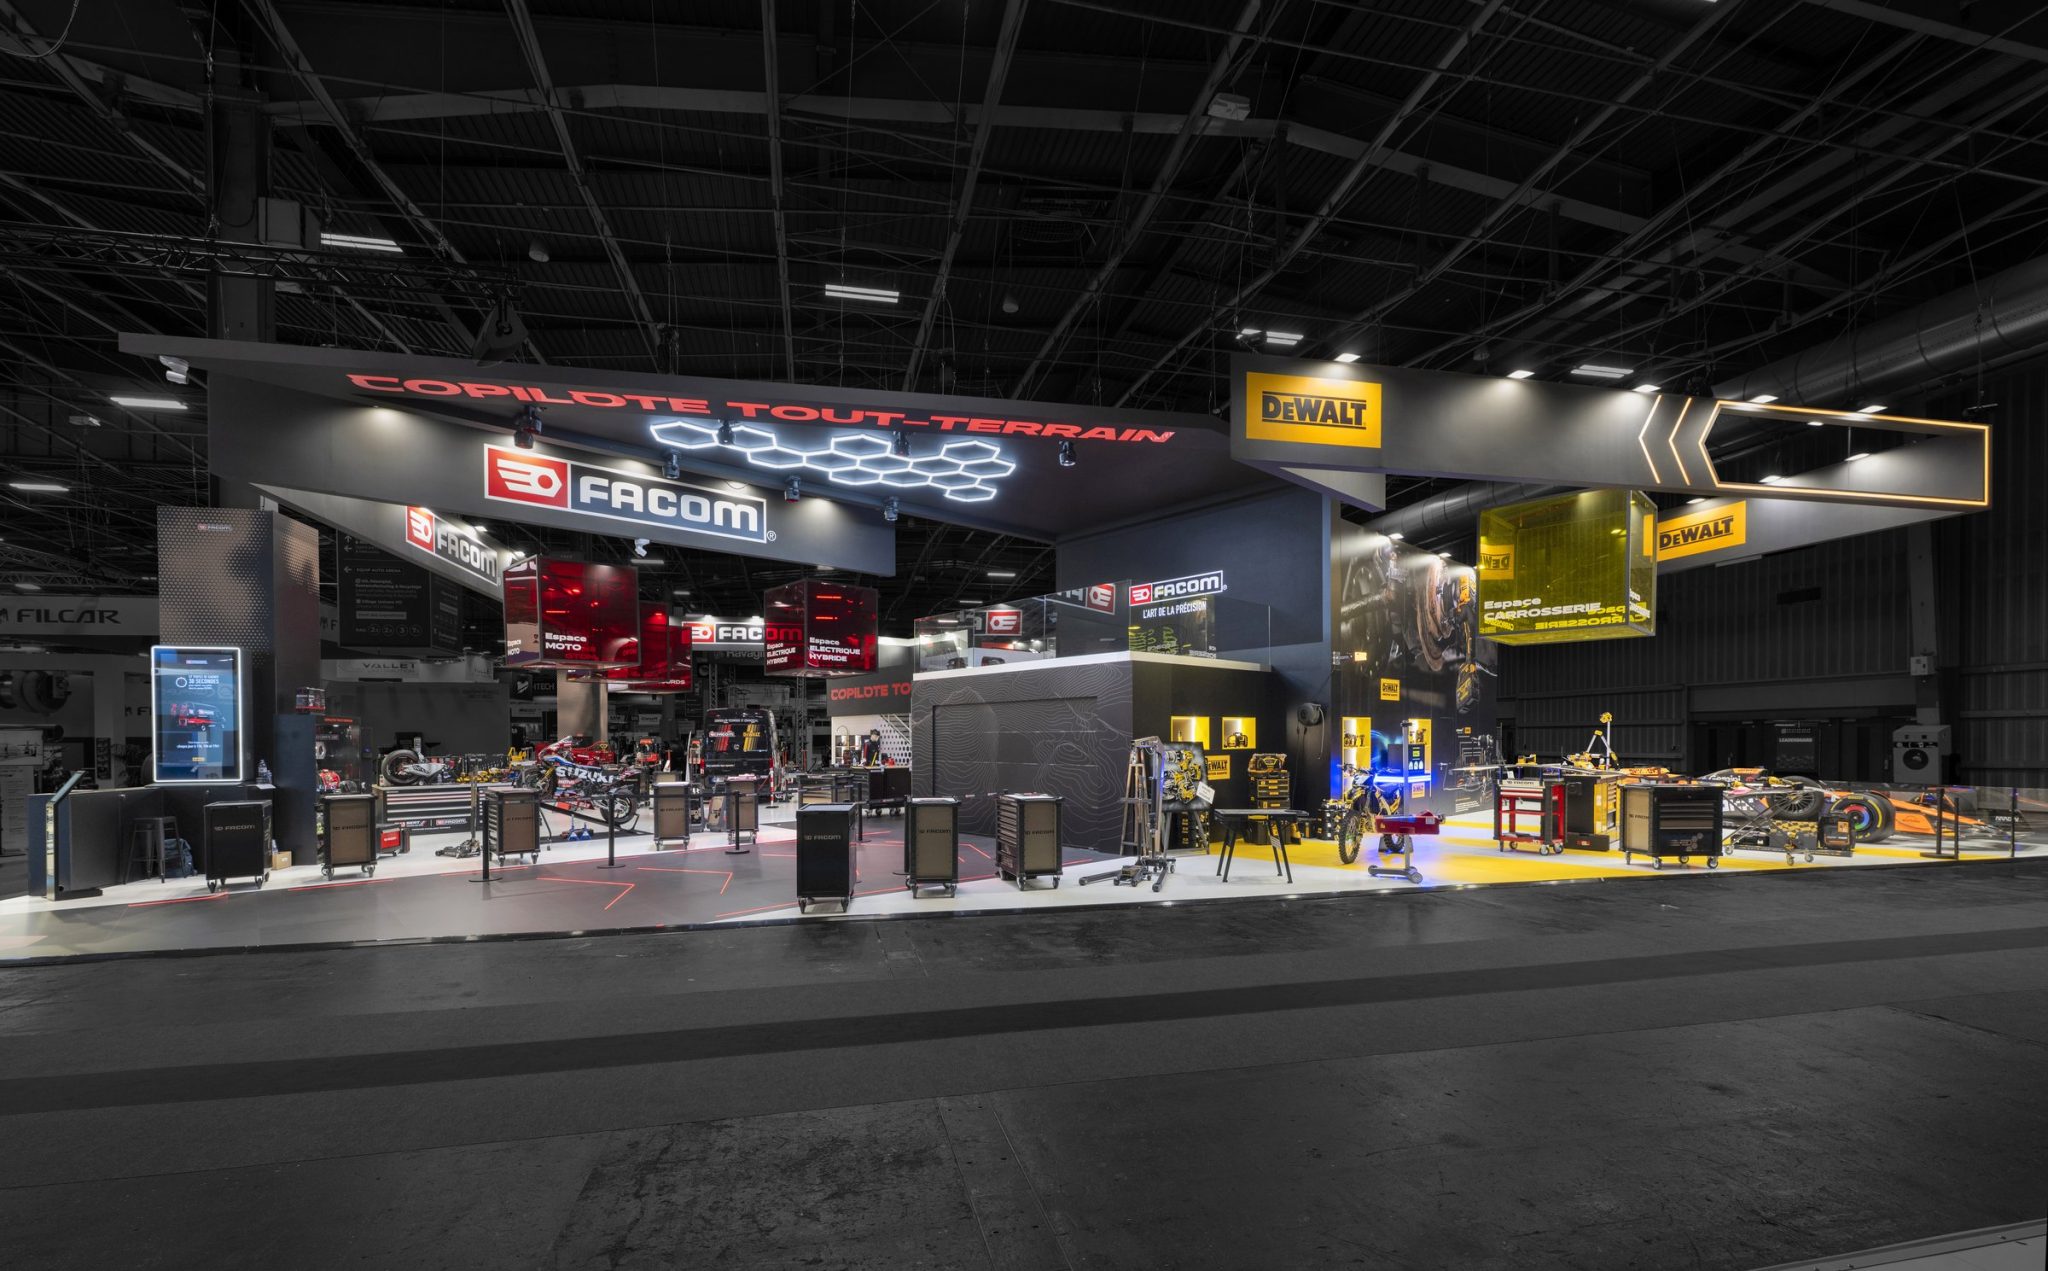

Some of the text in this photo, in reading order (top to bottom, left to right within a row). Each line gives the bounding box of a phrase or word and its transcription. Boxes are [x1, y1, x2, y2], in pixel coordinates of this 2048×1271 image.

[346, 373, 712, 414] COPILOTE
[1262, 394, 1366, 427] DEWALT
[578, 475, 759, 533] FACOM
[1659, 518, 1733, 549] DEWALT
[436, 526, 499, 578] FACOM
[1154, 576, 1219, 599] FACOM
[1143, 607, 1158, 619] L'ART
[1158, 605, 1167, 616] DE
[1167, 603, 1176, 616] LA
[1484, 597, 1541, 610] Espace
[1484, 602, 1601, 621] CARROSSERIE
[17, 608, 121, 624] FILCAR
[545, 632, 587, 644] Espace
[809, 637, 840, 646] Espace
[545, 642, 582, 652] MOTO
[766, 647, 797, 659] ELECTRIQUE
[809, 645, 861, 656] ELECTRIQUE
[809, 653, 848, 663] HYBRIDE
[830, 682, 889, 701] COPILOTE
[555, 766, 614, 784] SUZUKI
